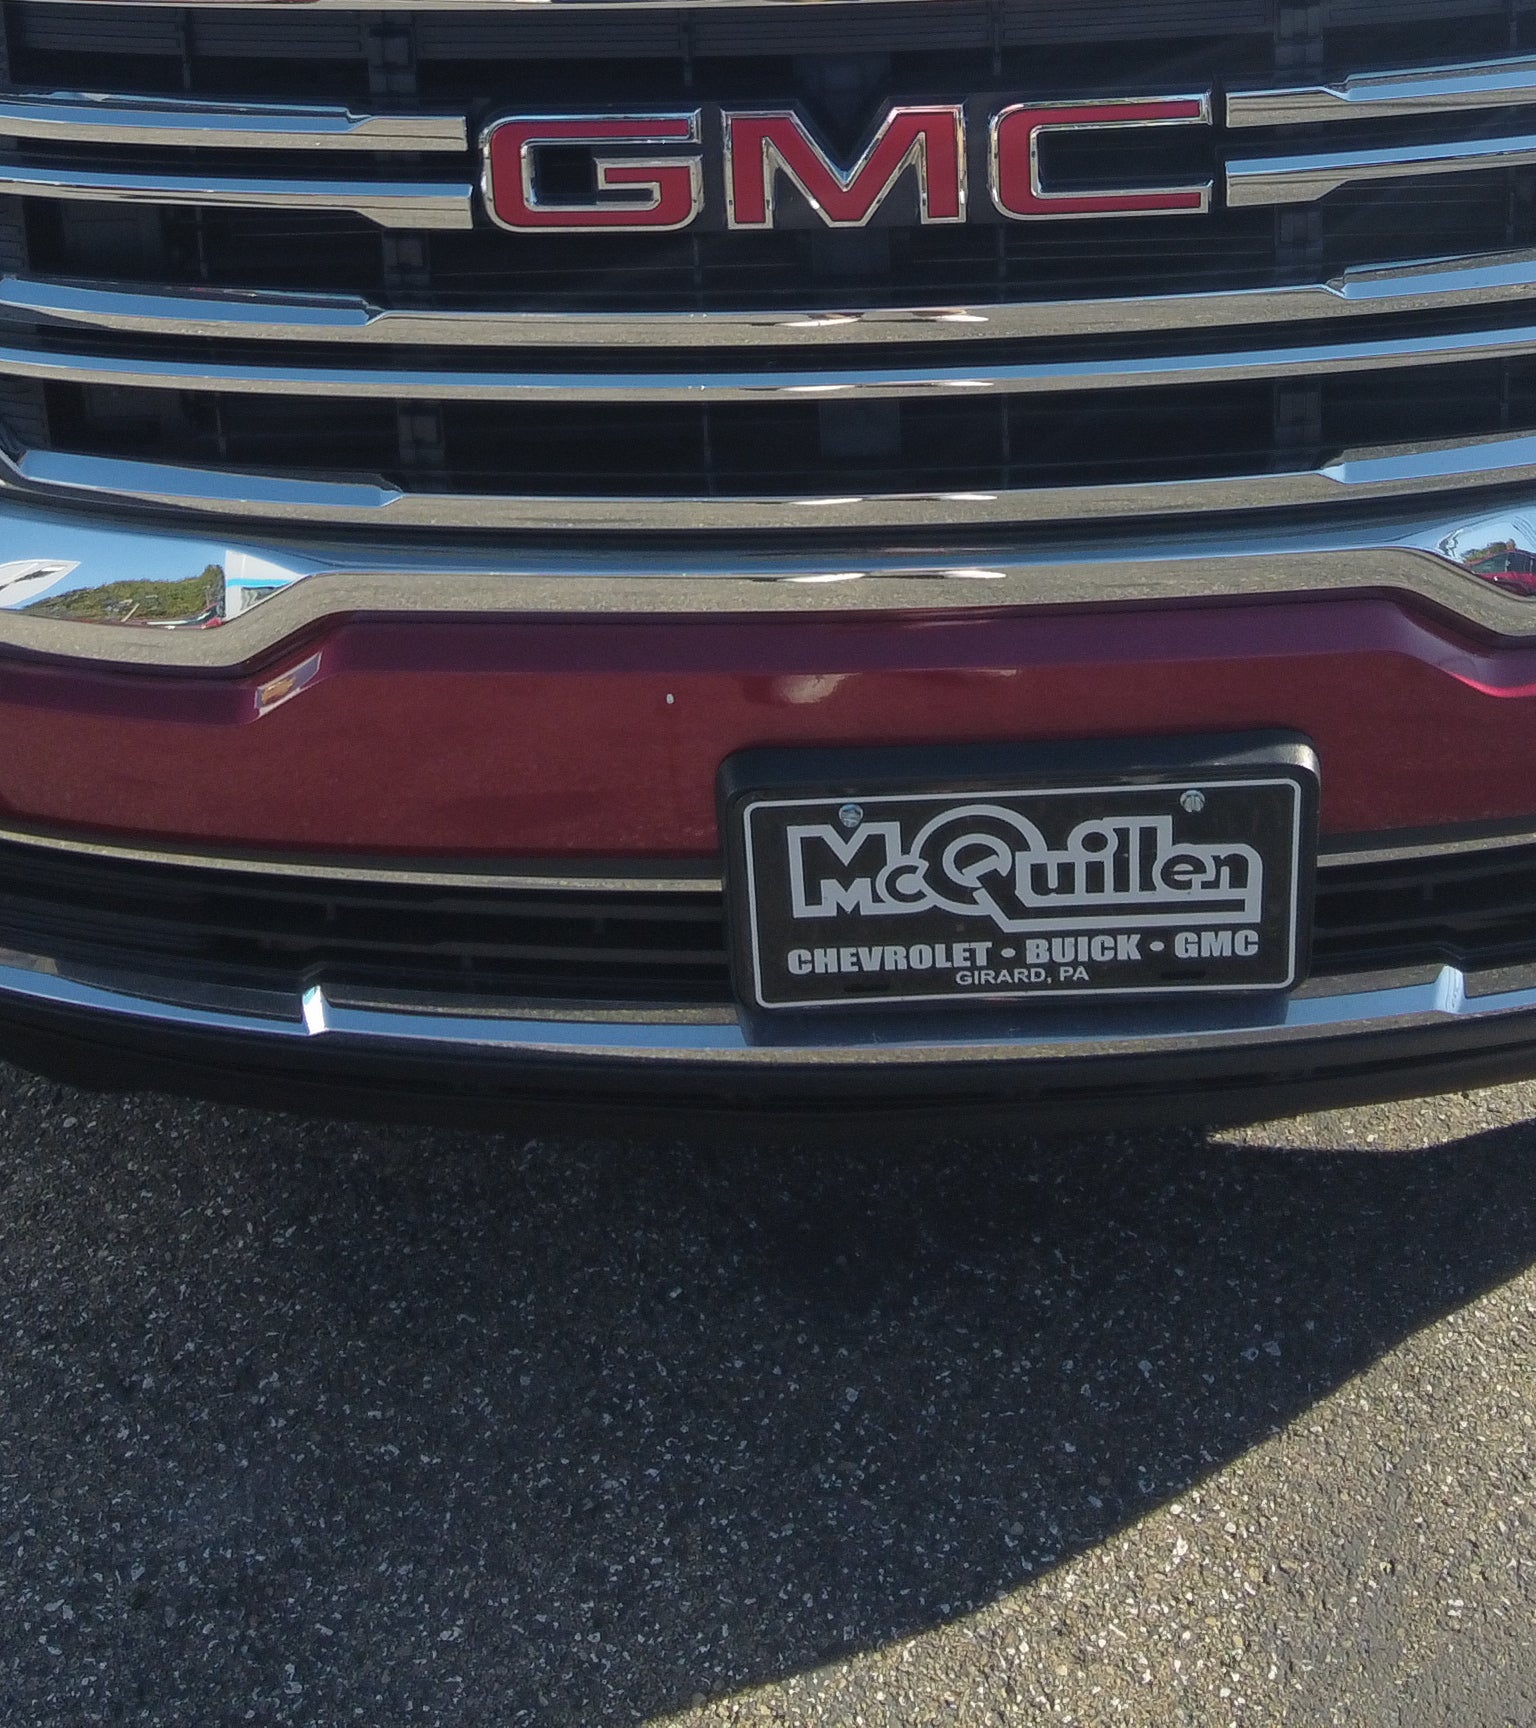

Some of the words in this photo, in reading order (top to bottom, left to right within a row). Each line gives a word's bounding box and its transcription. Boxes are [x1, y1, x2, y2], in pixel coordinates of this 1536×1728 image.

[479, 87, 1213, 233] GMC
[786, 804, 1263, 933] McQuillen
[786, 941, 993, 975] CHEVROLET
[1025, 933, 1142, 965] BUICK
[1173, 928, 1260, 960] GMC
[954, 967, 1053, 986] GIRARD,
[1058, 964, 1090, 983] PA
